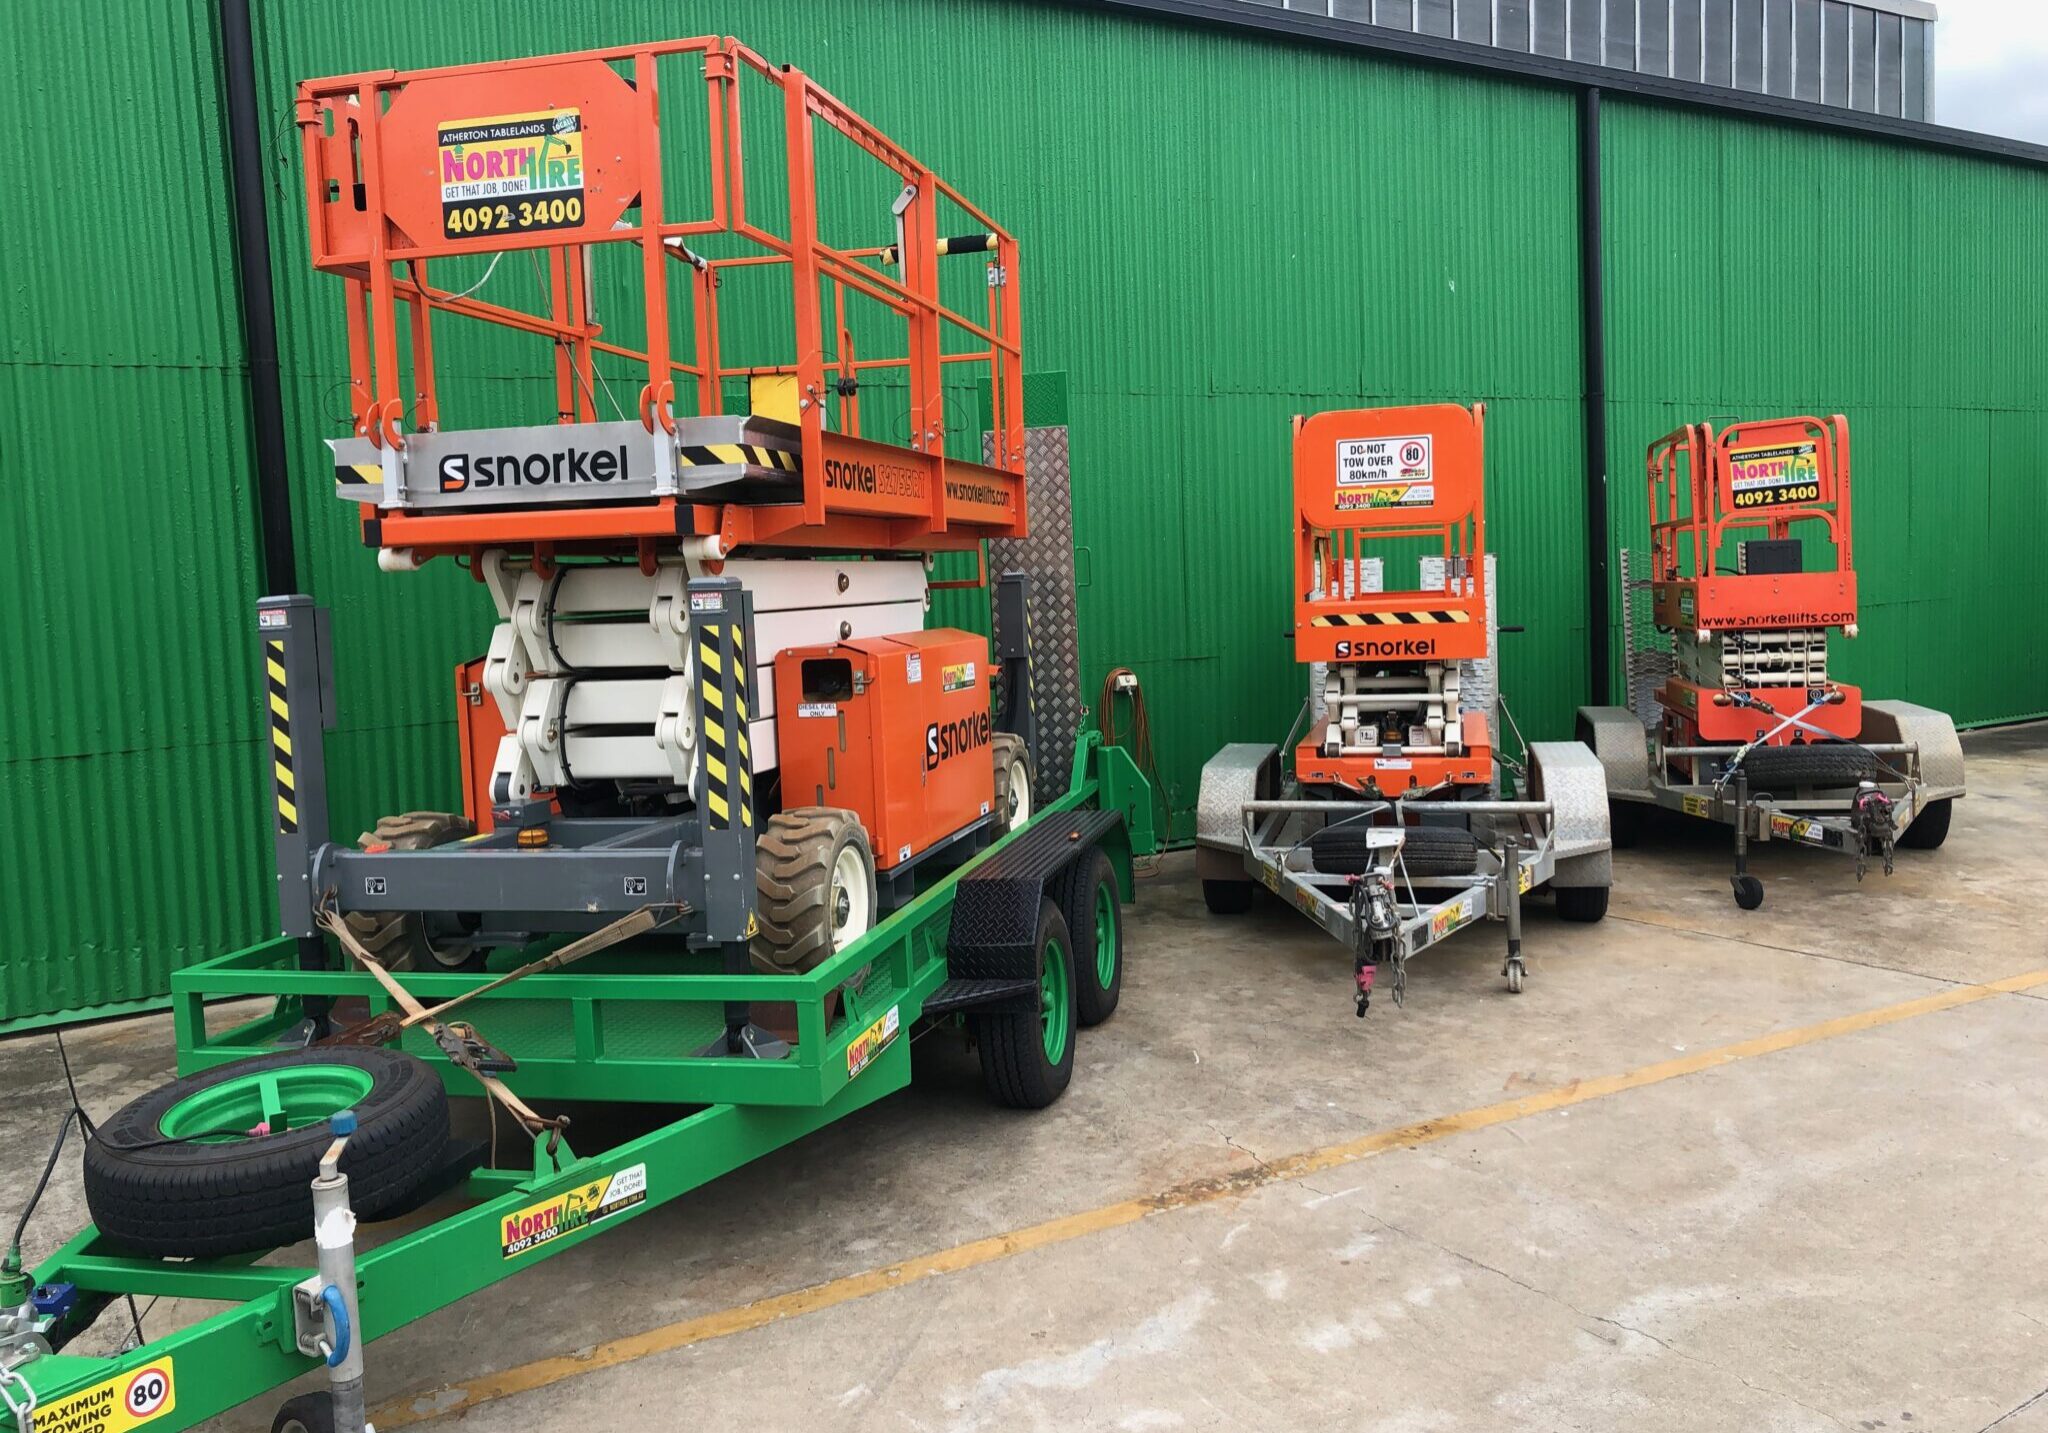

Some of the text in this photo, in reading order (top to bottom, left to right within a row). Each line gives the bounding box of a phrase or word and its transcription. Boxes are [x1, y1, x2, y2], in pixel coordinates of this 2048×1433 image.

[442, 129, 488, 143] ATHERTON
[490, 124, 545, 138] TABLELANDS
[445, 179, 527, 198] GET THAT JOB, DONE!
[447, 197, 581, 233] 4092 3400
[1350, 443, 1386, 455] DO NOT
[1406, 447, 1419, 461] 80
[1732, 453, 1760, 461] ATHERTON
[1761, 449, 1794, 458] TABLELANDS
[474, 445, 628, 488] snorkel
[1343, 456, 1393, 468] TOW OVER
[825, 459, 877, 494] snorkel
[1349, 469, 1388, 480] 80km/h
[1735, 485, 1817, 506] 4092 3400
[1354, 639, 1435, 656] snorkel
[799, 702, 836, 711] DIESEL FUEL
[810, 710, 824, 718] ONLY
[940, 705, 992, 761] snorkel
[616, 1169, 643, 1186] GET THAT
[507, 1226, 559, 1254] 4092 3400
[133, 1378, 163, 1407] 80
[33, 1386, 114, 1430] MAXIMUM
